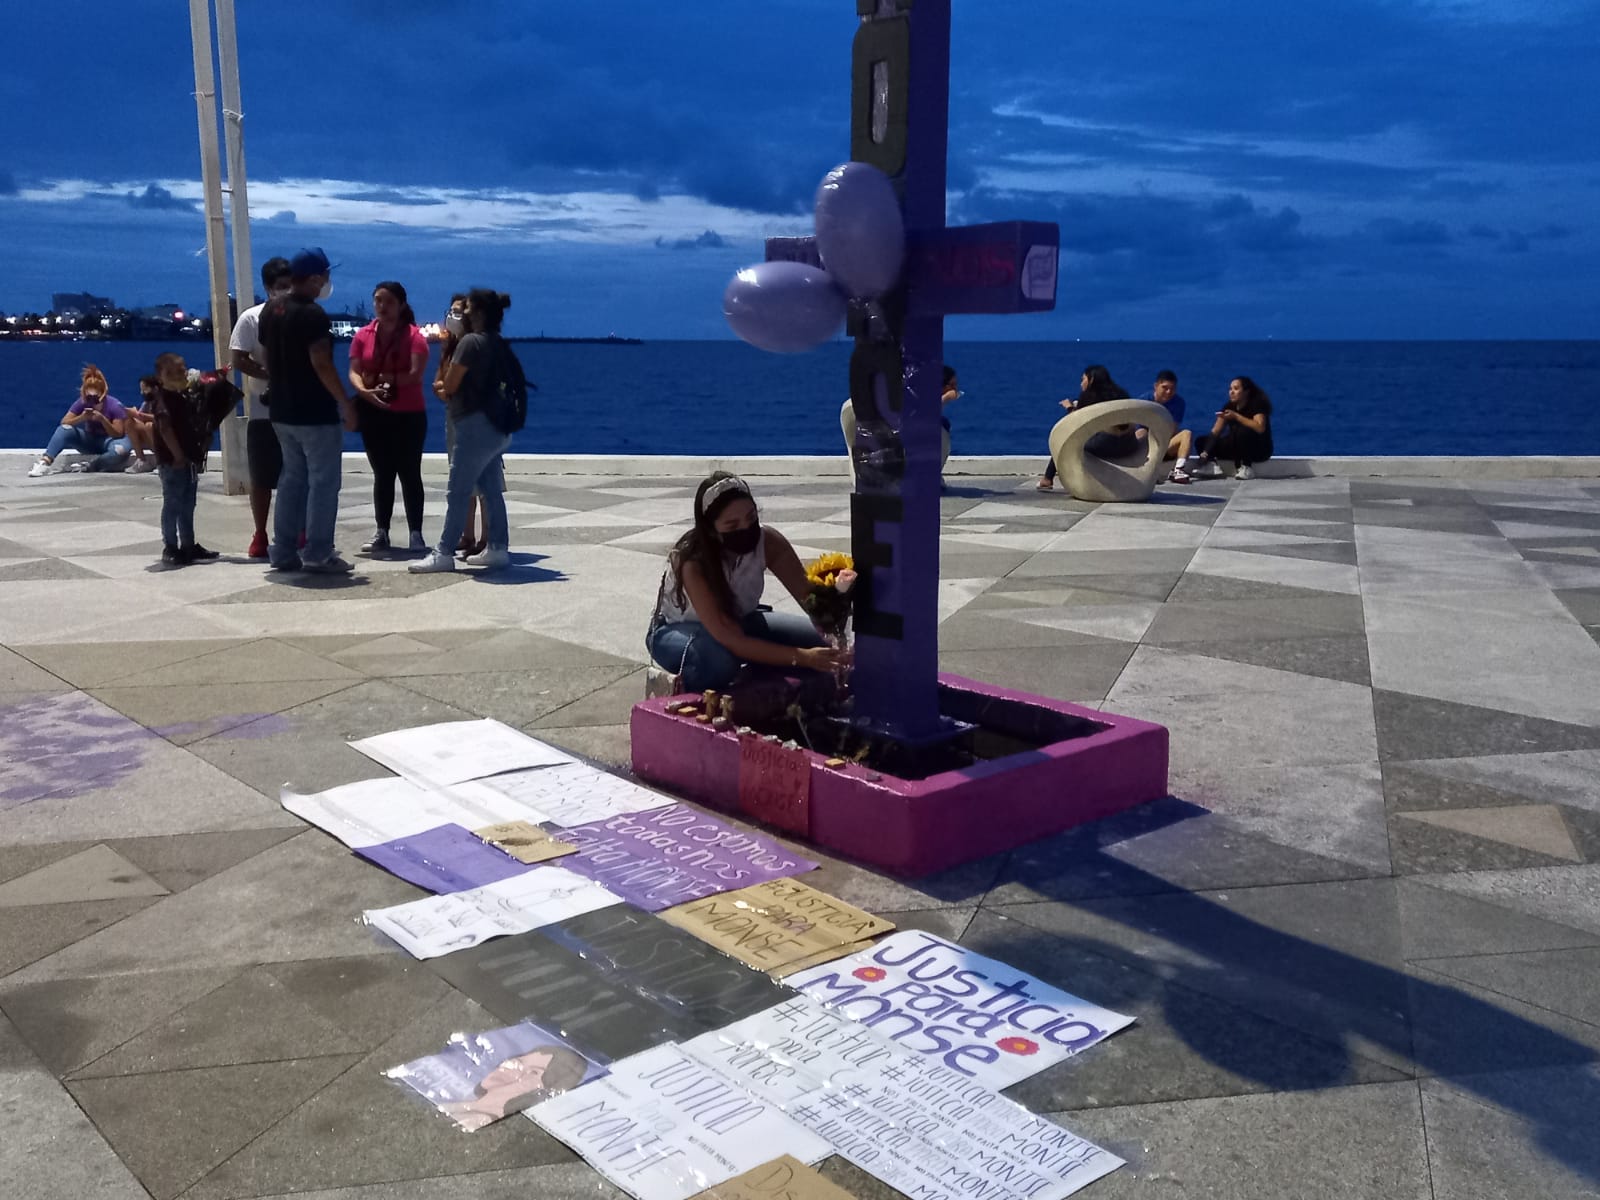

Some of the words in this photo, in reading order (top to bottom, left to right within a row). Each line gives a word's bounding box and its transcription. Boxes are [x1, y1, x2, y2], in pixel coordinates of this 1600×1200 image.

[605, 815, 692, 855] todas
[680, 849, 751, 880] nos
[685, 901, 805, 961] MONSE
[798, 972, 1000, 1077] Monse
[872, 933, 1108, 1051] Justicia
[638, 1057, 765, 1136] JUSTICIA
[843, 1083, 940, 1136] #JUSTICIA
[880, 1064, 974, 1120] #JUSTICIA
[1000, 1133, 1086, 1180] MONTSE
[903, 1055, 996, 1109] #JUSTICIA
[1021, 1119, 1106, 1167] MONTSE
[558, 1100, 686, 1181] MONTSE
